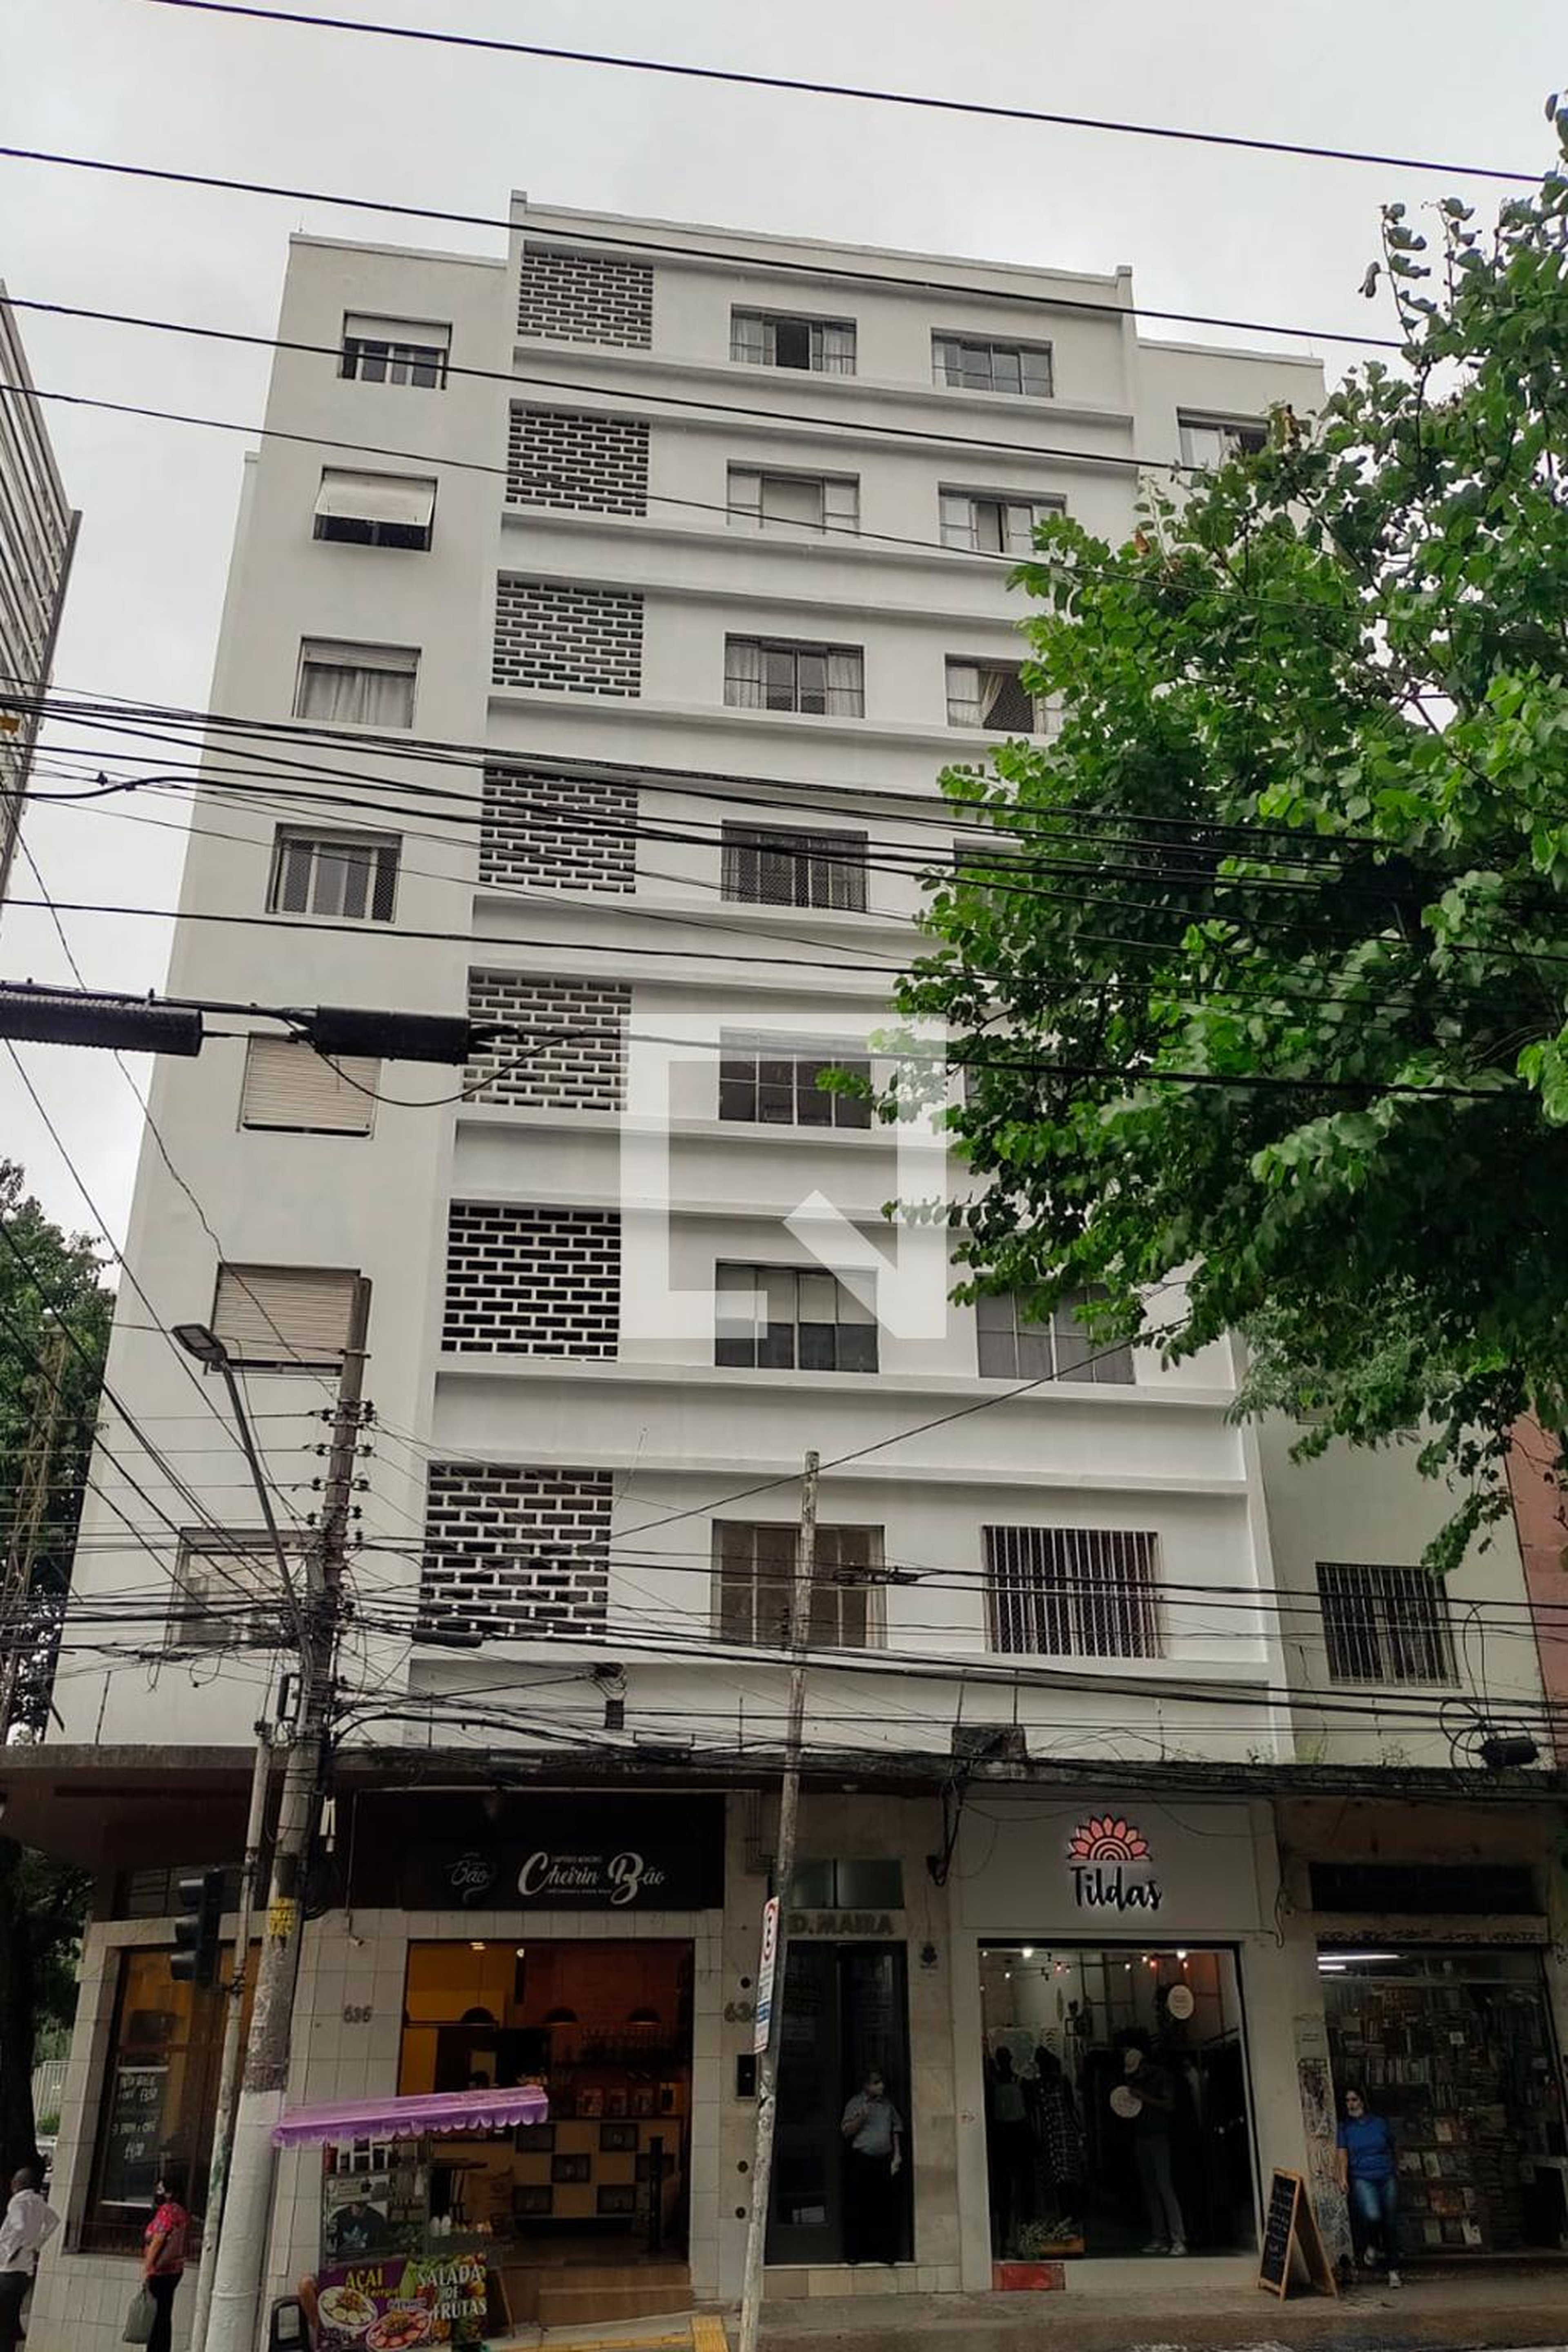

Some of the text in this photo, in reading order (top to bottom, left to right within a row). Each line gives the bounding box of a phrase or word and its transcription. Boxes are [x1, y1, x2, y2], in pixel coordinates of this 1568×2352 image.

[517, 1851, 666, 1905] Cheirin Bão
[1070, 1865, 1162, 1911] Tildas
[417, 2264, 482, 2287] SALADA
[430, 2299, 487, 2321] FRUTAS
